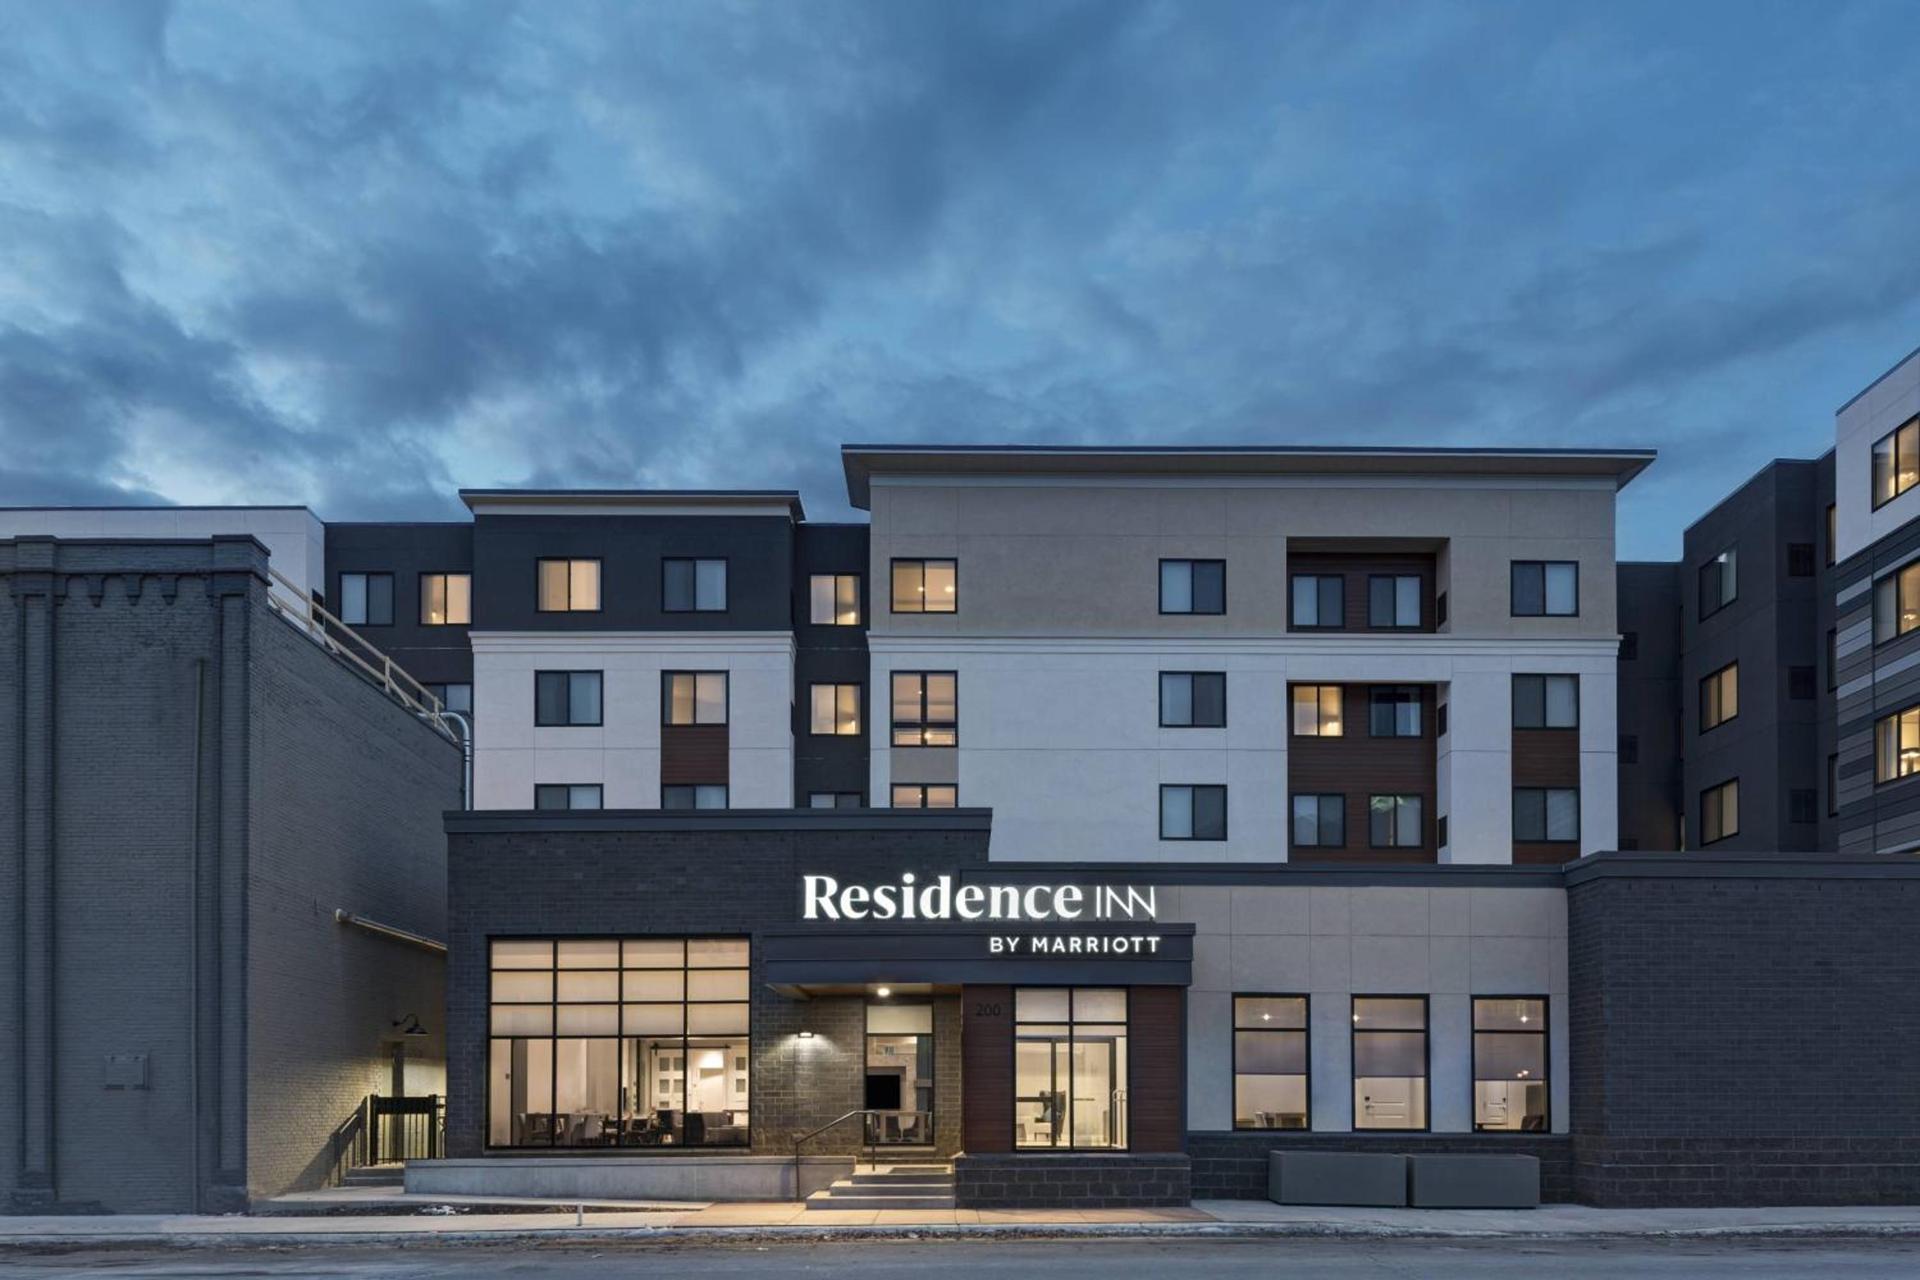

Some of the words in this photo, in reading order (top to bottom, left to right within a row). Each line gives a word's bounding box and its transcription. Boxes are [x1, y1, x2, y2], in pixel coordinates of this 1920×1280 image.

[803, 873, 1083, 919] Residence
[1096, 885, 1156, 918] INN
[990, 937, 1020, 953] BY
[1032, 937, 1161, 953] MARRIOTT
[976, 1003, 1001, 1017] 200
